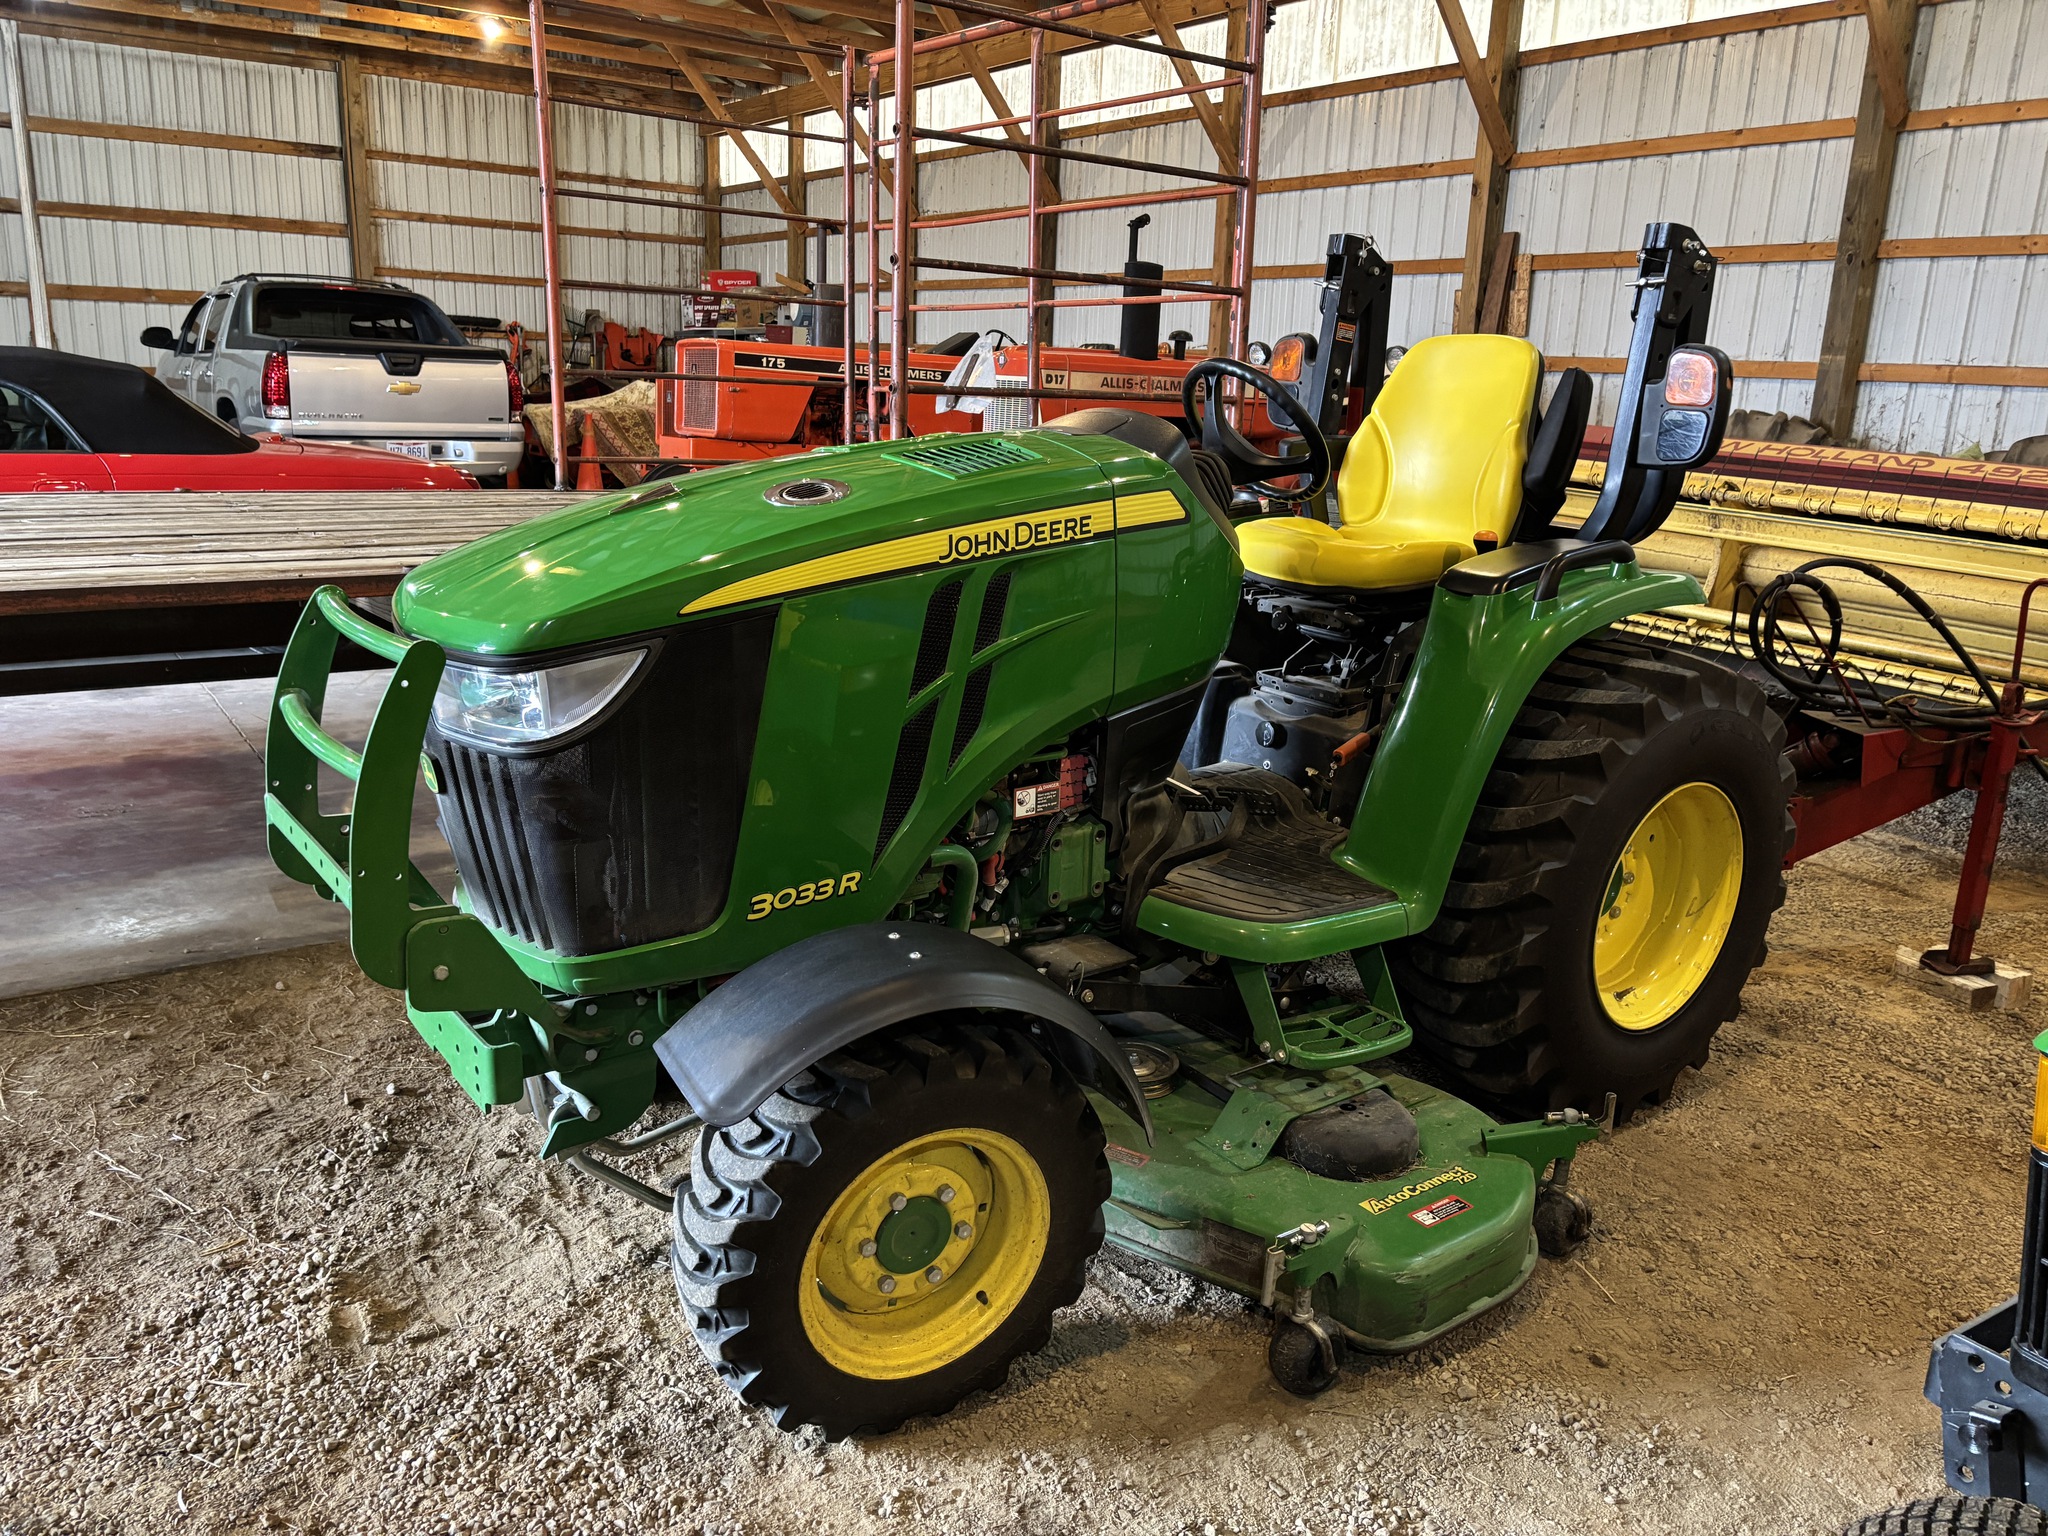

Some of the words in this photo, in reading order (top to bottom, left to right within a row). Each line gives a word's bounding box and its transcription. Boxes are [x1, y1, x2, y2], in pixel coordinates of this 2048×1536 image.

[761, 357, 786, 369] 175
[1045, 373, 1065, 386] D17
[407, 446, 426, 458] 8691
[1758, 444, 1935, 468] HOLLAND
[1954, 464, 2048, 482] 492
[938, 529, 1009, 561] JOHN
[1014, 515, 1092, 547] DEERE
[1453, 1173, 1477, 1185] 72D
[1371, 1166, 1468, 1213] AutoConnect
